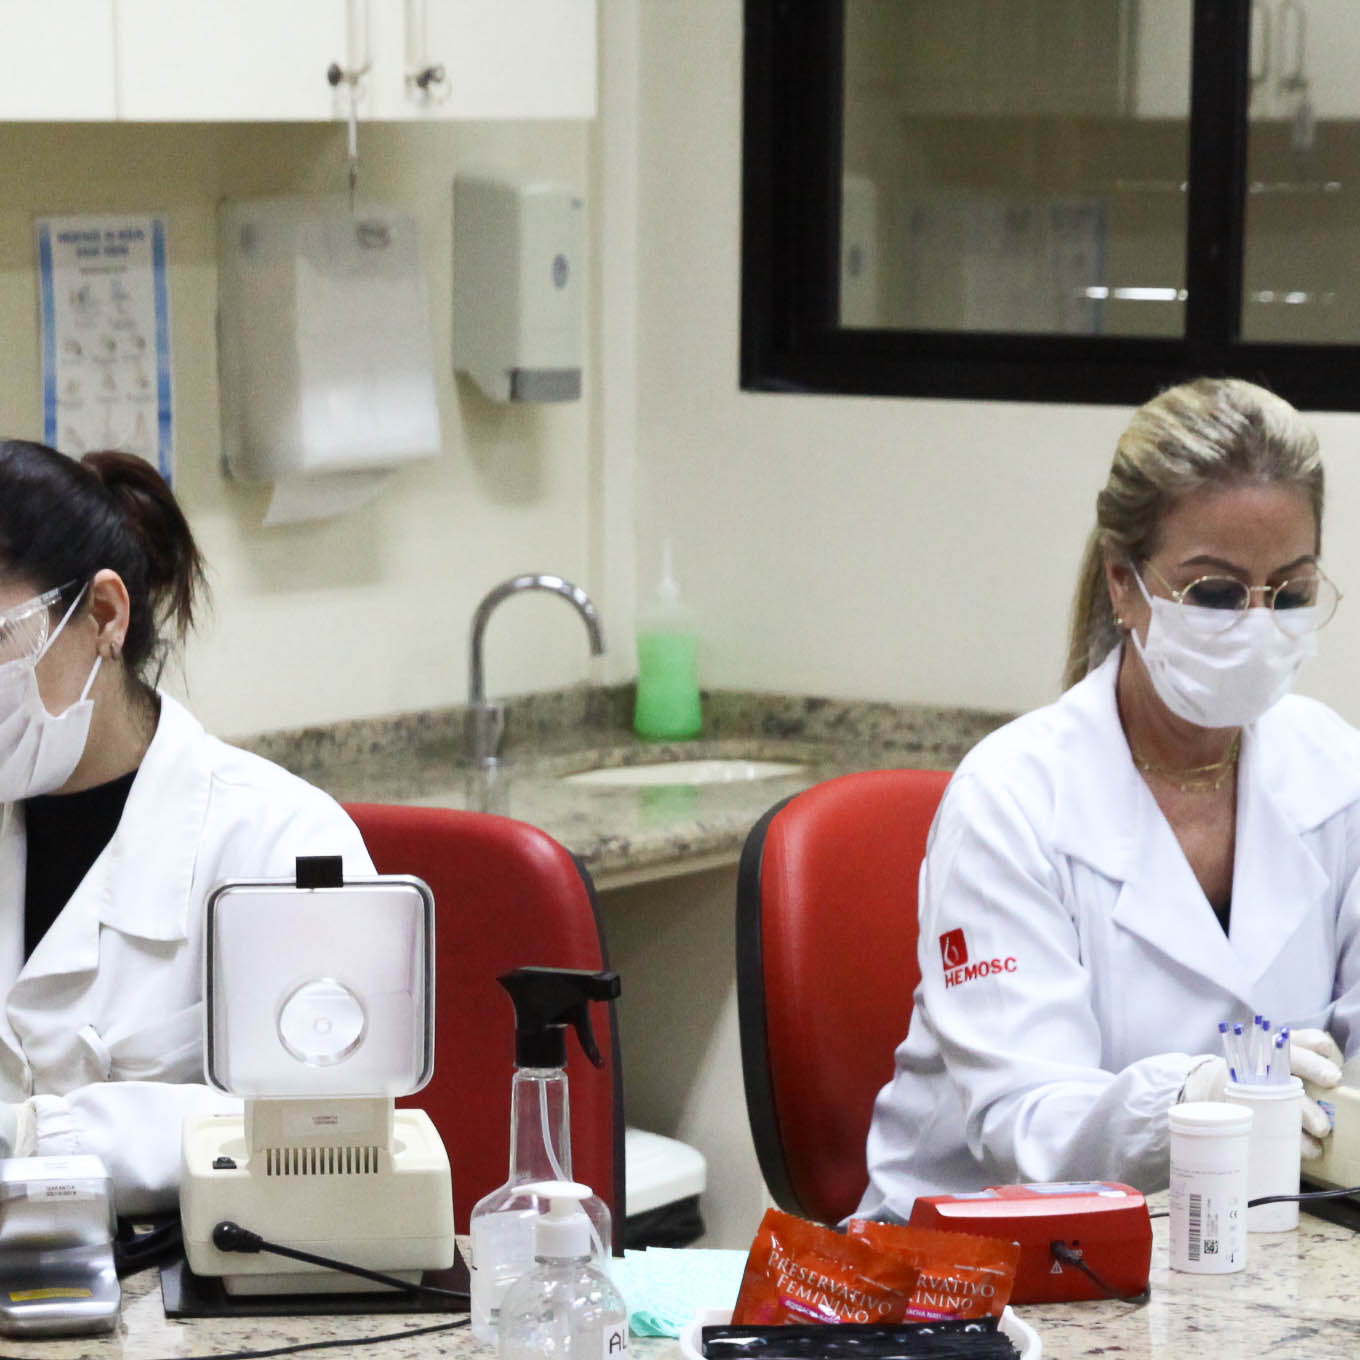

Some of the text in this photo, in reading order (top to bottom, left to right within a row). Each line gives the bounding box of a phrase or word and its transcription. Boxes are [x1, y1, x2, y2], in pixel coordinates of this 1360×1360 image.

[944, 956, 1018, 989] HEMOSC
[767, 1250, 892, 1314] PRESERVATIVO
[776, 1273, 870, 1323] FEMININO
[916, 1273, 996, 1298] RVATIVO
[915, 1290, 973, 1310] ININO
